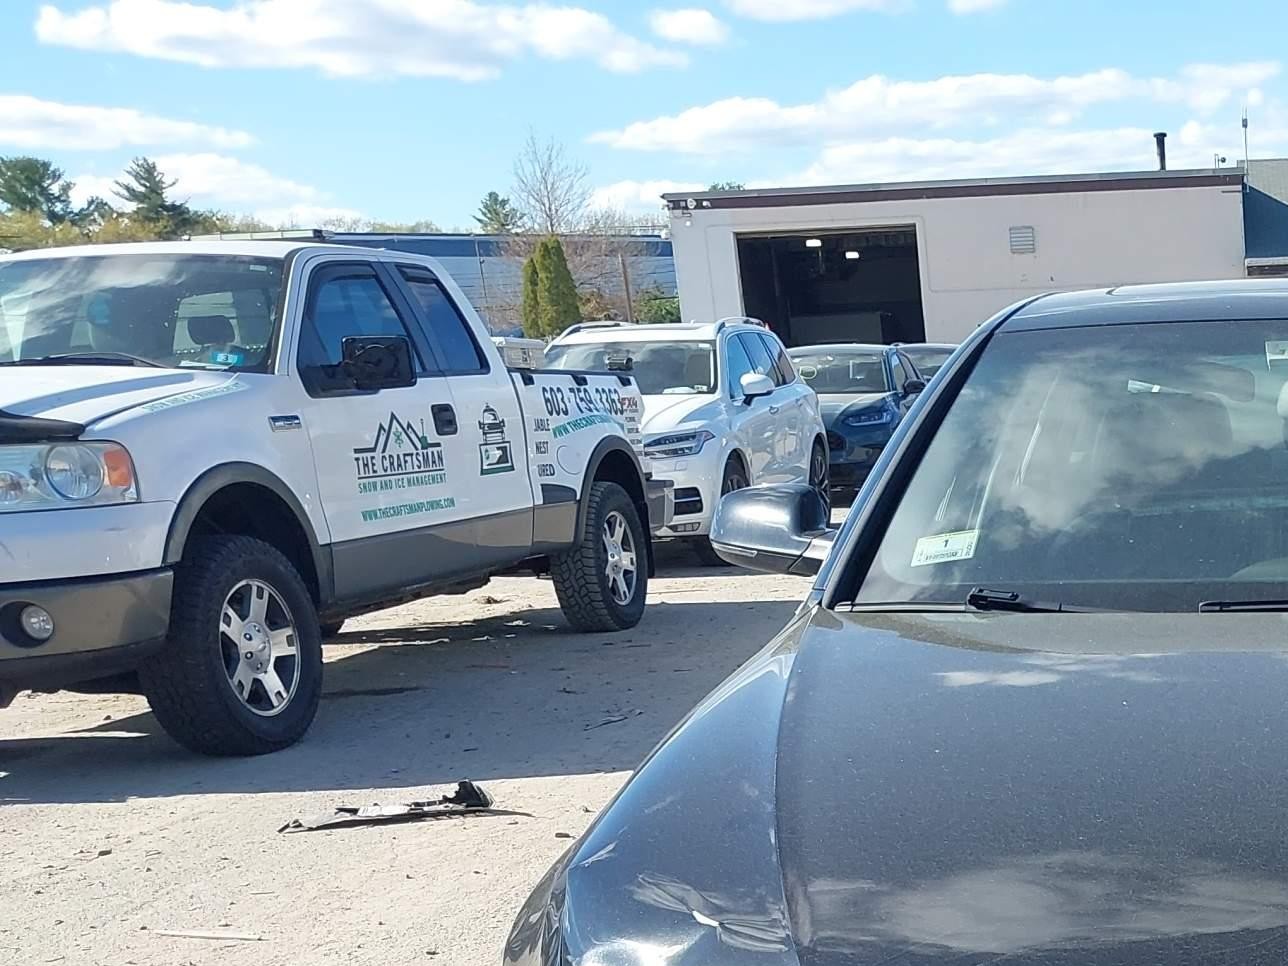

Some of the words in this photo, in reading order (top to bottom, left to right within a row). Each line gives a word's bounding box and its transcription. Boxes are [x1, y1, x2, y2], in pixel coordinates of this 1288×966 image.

[535, 441, 549, 455] NEST
[354, 455, 378, 476] THE
[381, 450, 444, 473] CRAFTSMAN
[358, 480, 378, 494] SNOW
[380, 479, 393, 491] AND
[394, 478, 405, 489] ICE
[407, 473, 447, 488] MANAGEMENT
